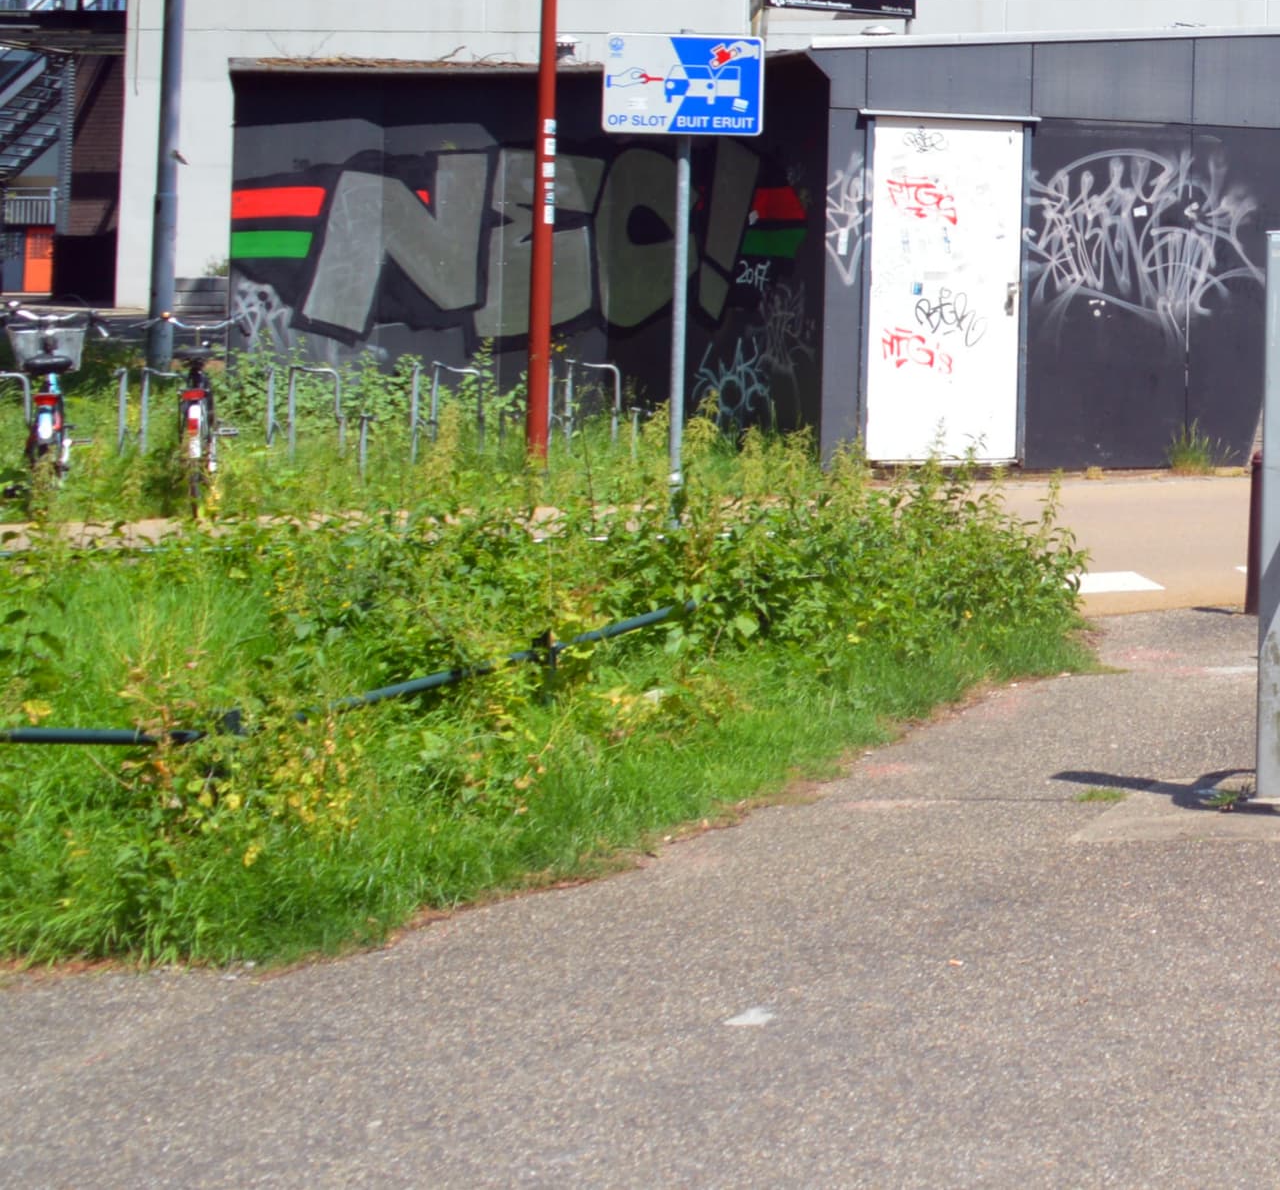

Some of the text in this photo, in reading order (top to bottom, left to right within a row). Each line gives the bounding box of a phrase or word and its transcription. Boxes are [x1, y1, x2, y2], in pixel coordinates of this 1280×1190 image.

[607, 114, 755, 129] OP SLOT BUIT ERUIT
[736, 260, 771, 291] 2017
